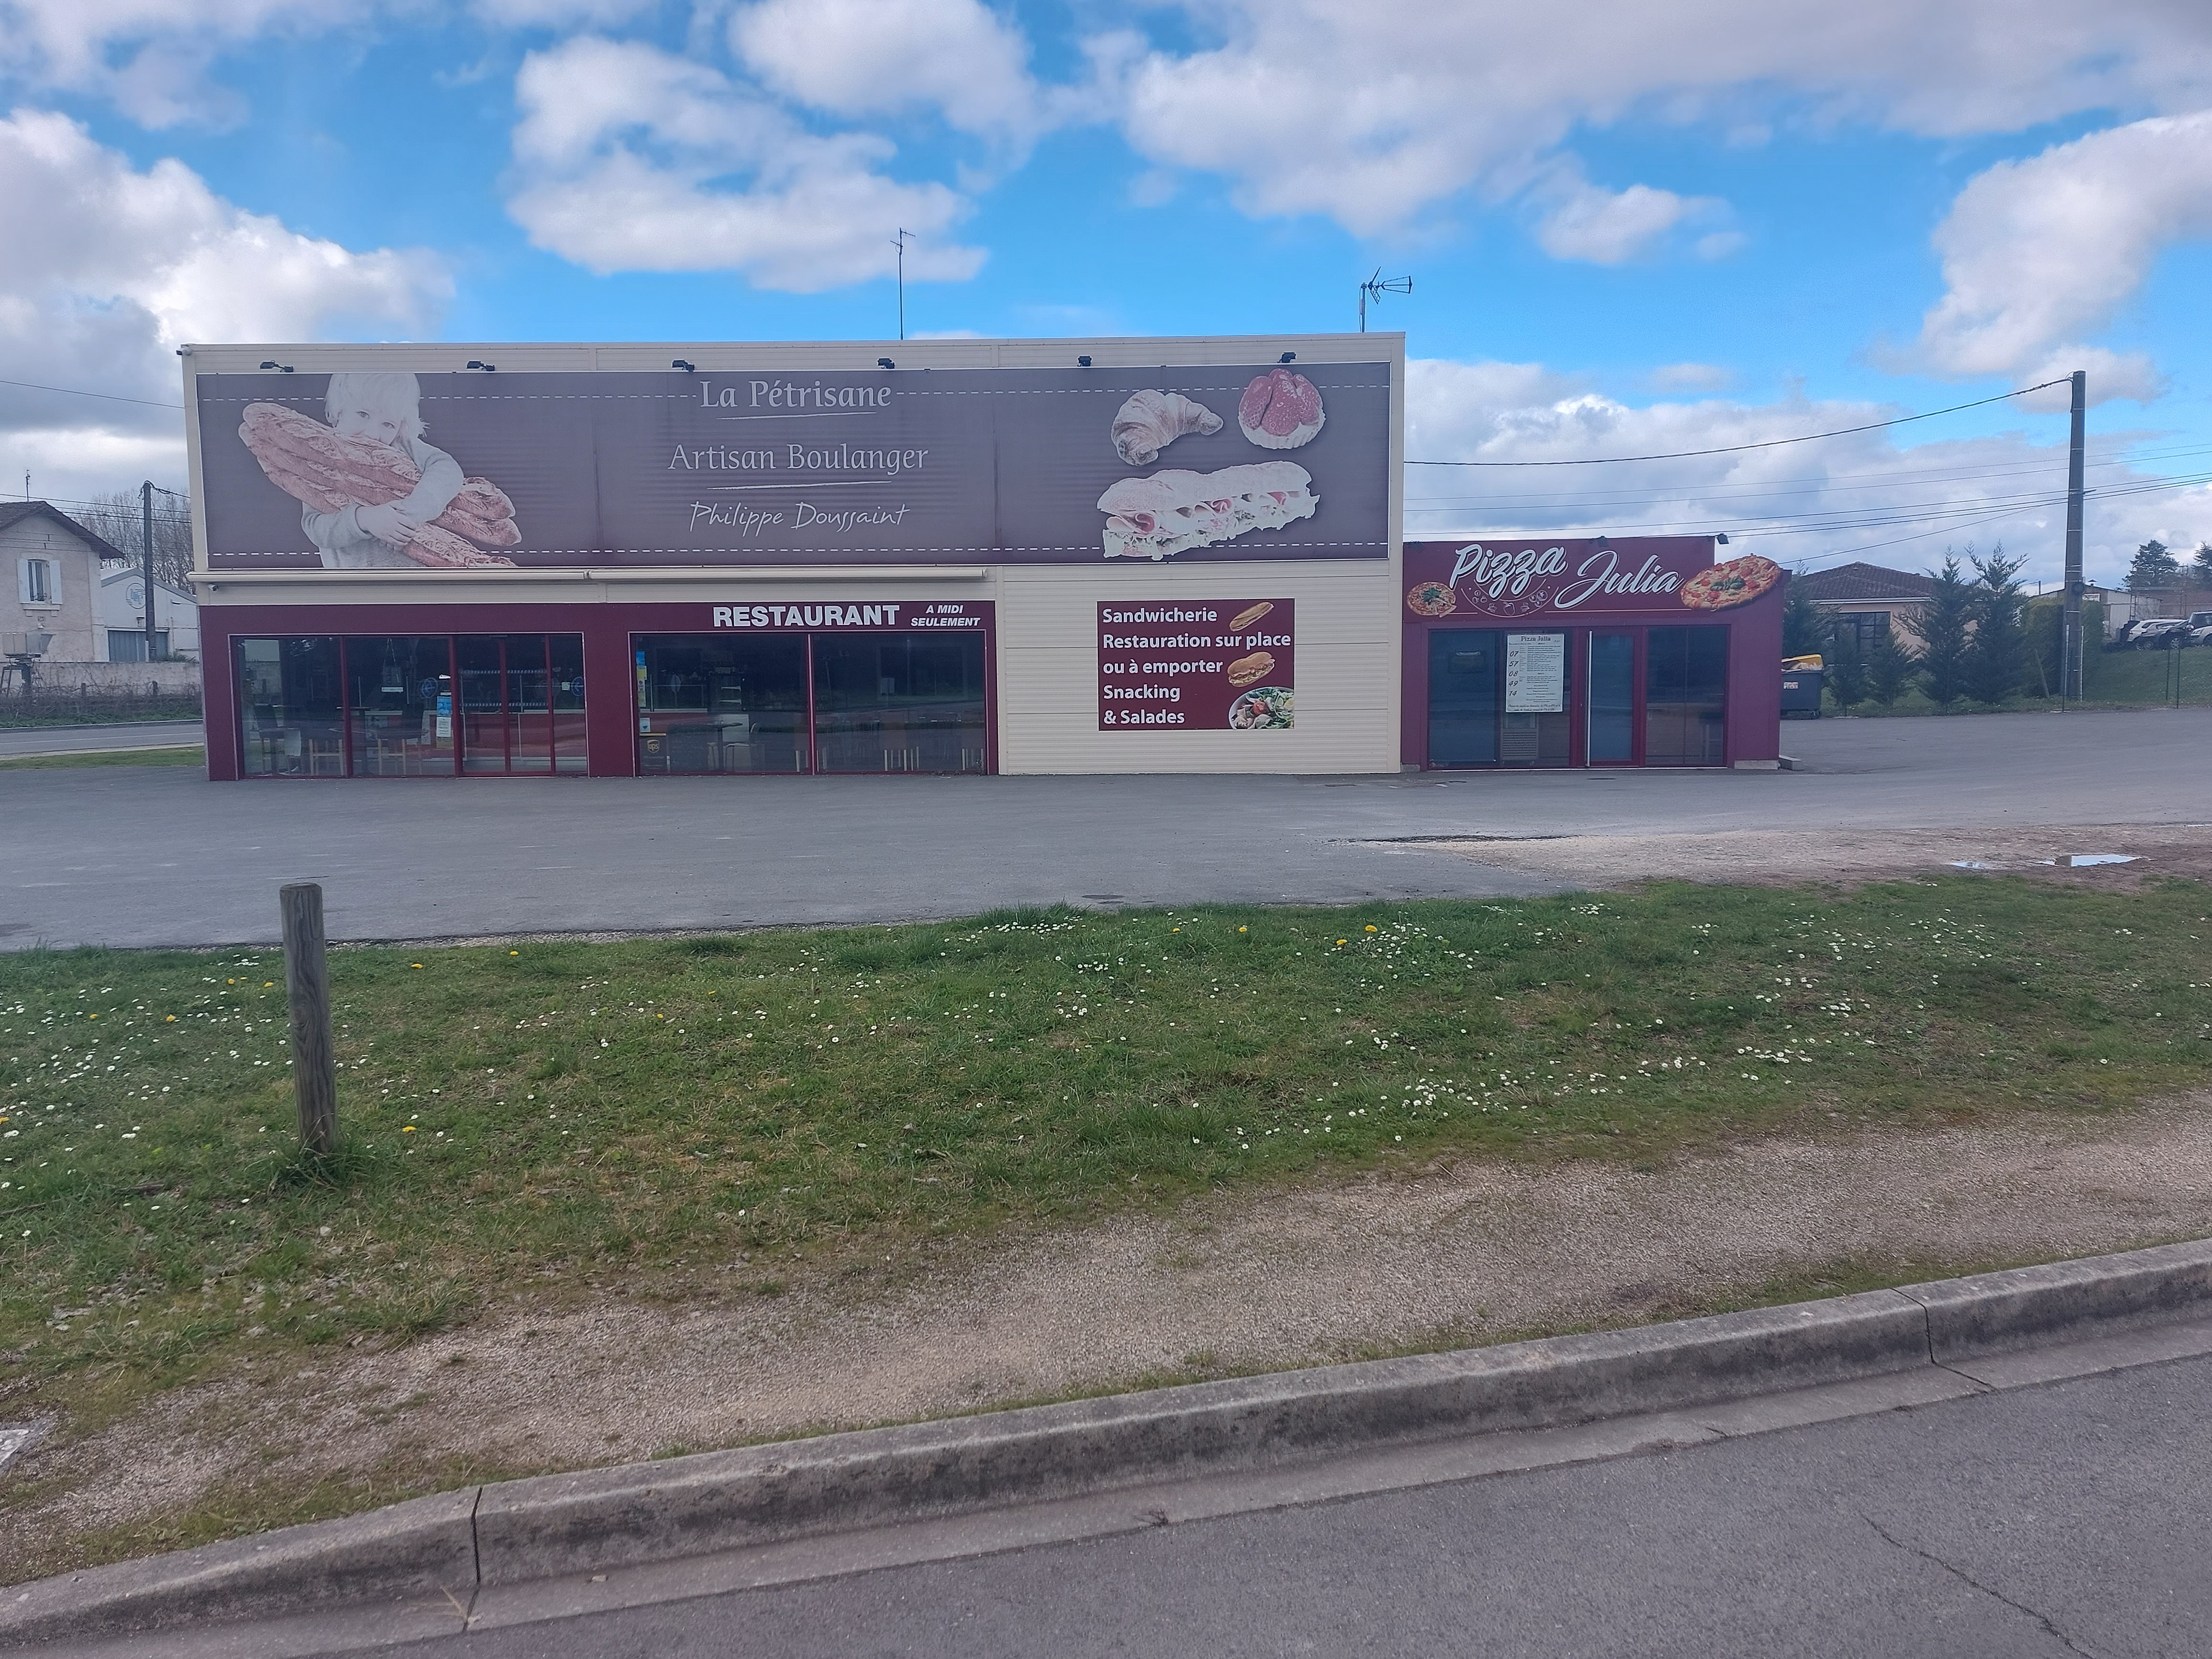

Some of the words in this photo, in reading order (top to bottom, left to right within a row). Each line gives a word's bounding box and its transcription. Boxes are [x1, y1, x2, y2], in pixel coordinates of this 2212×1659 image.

[700, 381, 738, 408] La
[749, 379, 892, 408] Pétrisane
[668, 444, 776, 469] Artisan
[786, 442, 929, 475] Boulanger
[689, 501, 784, 537] Philippe
[790, 501, 910, 532] Doussaint
[1449, 543, 1569, 600] Pizza
[1554, 550, 1685, 609] Julia
[713, 605, 900, 627] RESTAURANT
[926, 605, 935, 614] A
[937, 605, 964, 614] MIDI
[1103, 607, 1217, 623] Sandwicherie
[910, 617, 981, 627] SEULEMENT
[1103, 633, 1211, 648] Restauration
[1216, 635, 1242, 647] sur
[1246, 631, 1291, 650] place
[1103, 662, 1124, 674] ou
[1129, 659, 1139, 674] à
[1142, 660, 1223, 676] emporter
[1103, 684, 1181, 702] Snacking
[1104, 710, 1117, 724] &
[1120, 709, 1185, 724] Salades
